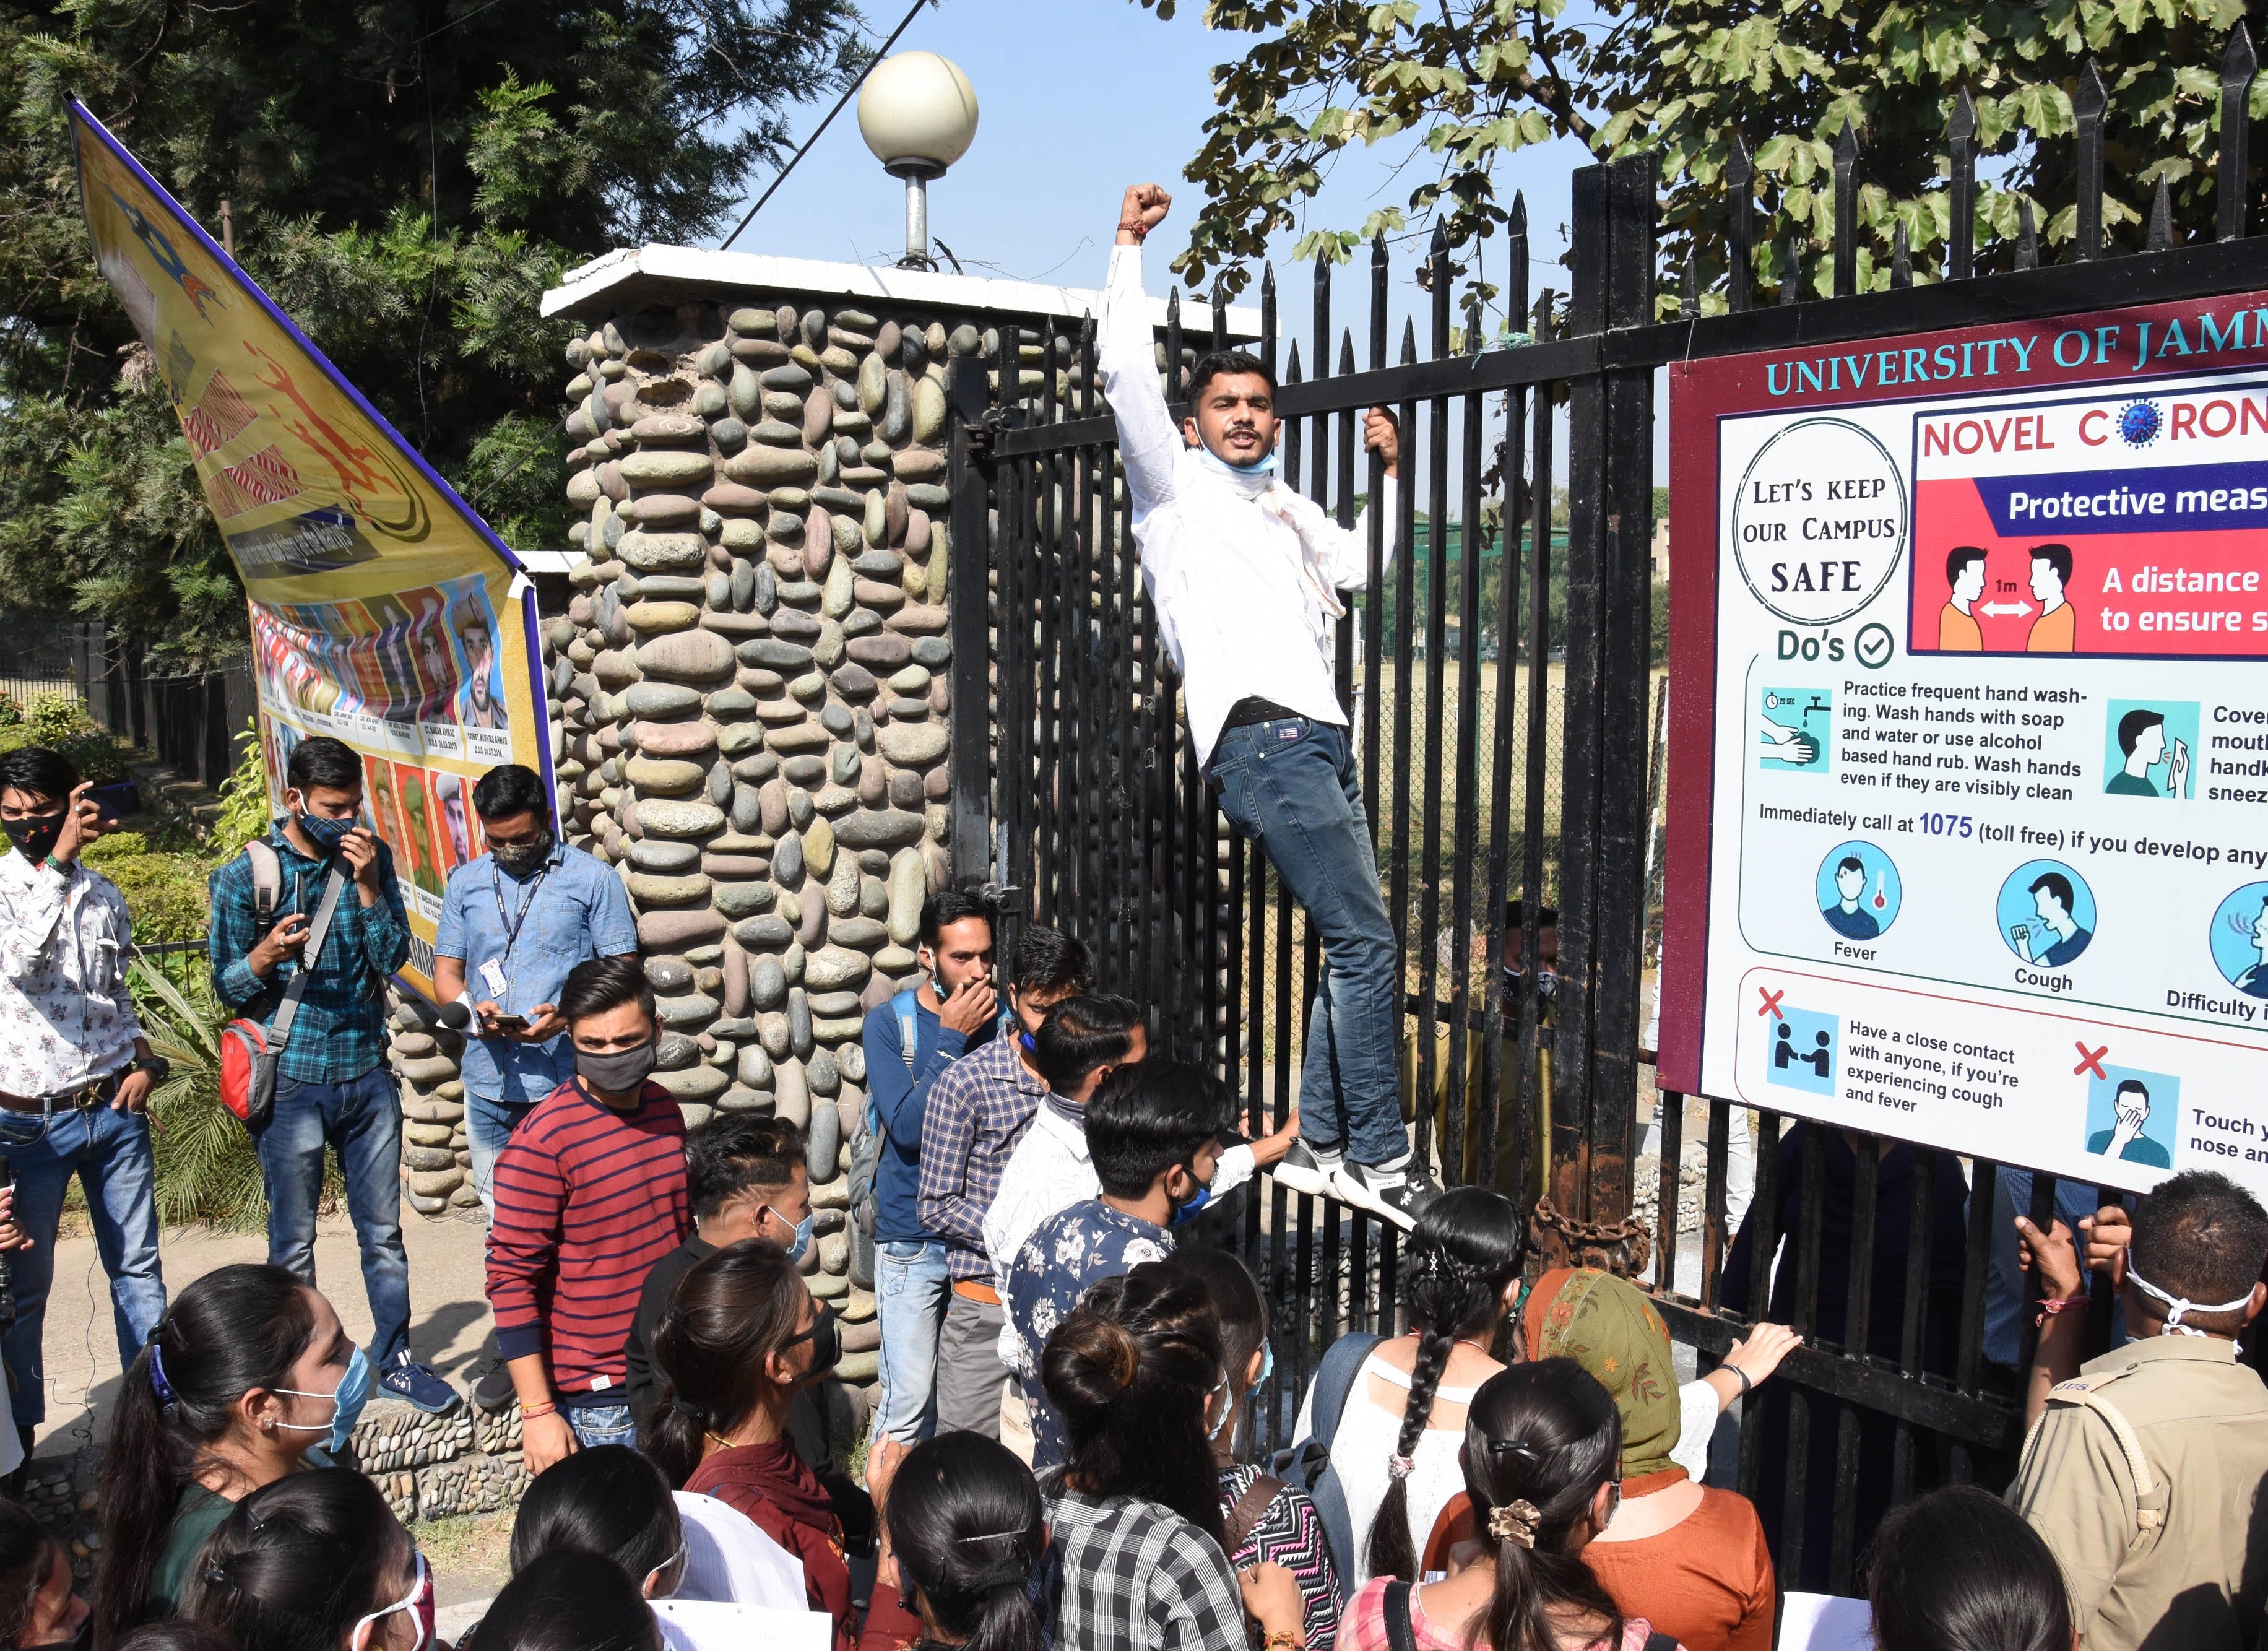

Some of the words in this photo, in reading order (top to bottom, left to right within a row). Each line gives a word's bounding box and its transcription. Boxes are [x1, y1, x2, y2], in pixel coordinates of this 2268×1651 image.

[1767, 336, 2037, 395] UNIVERSITY
[2054, 326, 2119, 367] OF
[1925, 416, 2054, 456] NOVEL
[2010, 487, 2165, 519] Protective
[1772, 561, 1861, 592] SAFE
[1996, 579, 2017, 593] 1m
[2102, 568, 2122, 592] A
[2132, 566, 2259, 592] distance
[2101, 607, 2129, 630] to
[2139, 612, 2241, 631] ensure
[1778, 629, 1844, 661] Do's
[1845, 681, 1906, 697] Practice
[1911, 683, 1980, 701] frequent
[1986, 685, 2027, 701] hand
[2034, 688, 2087, 703] wash-
[1844, 703, 1870, 721] ing.
[1876, 704, 1918, 720] Wash
[1925, 707, 1974, 723] hands
[1981, 709, 2015, 724] with
[2022, 714, 2064, 730] soap
[2214, 706, 2268, 724] Cove
[1842, 727, 1869, 740] and
[1876, 729, 1918, 743] water
[1923, 734, 1939, 744] or
[1946, 735, 1973, 746] use
[1980, 733, 2041, 750] alcohol
[1842, 748, 1887, 764] based
[1893, 751, 1931, 766] hand
[1937, 755, 1968, 769] rub.
[1975, 756, 2020, 773] Wash
[2028, 759, 2081, 776] hands
[1841, 773, 1876, 786] even
[1882, 773, 1892, 787] if
[1896, 774, 1929, 793] they
[1935, 780, 1960, 792] are
[1965, 779, 2020, 800] visibly
[2026, 784, 2072, 800] clean
[1760, 804, 1857, 830] Immediately
[1863, 815, 1891, 830] call
[1898, 818, 1913, 832] at
[1920, 813, 1972, 838] 1075
[1980, 823, 2014, 843] (toll
[2020, 826, 2064, 851] free)
[2072, 831, 2084, 847] if
[2090, 837, 2126, 854] you
[2134, 837, 2219, 865] develop
[2227, 849, 2267, 869] any
[1835, 942, 1876, 960] Fever
[2015, 968, 2072, 992] Cough
[2167, 990, 2256, 1021] Difficulty
[1851, 1021, 1887, 1039] Have
[1892, 1032, 1900, 1042] a
[1906, 1033, 1947, 1051] close
[1953, 1043, 2014, 1064] contact
[1849, 1044, 1879, 1060] with
[1885, 1053, 1945, 1075] anyone,
[1952, 1062, 1962, 1076] if
[1846, 1065, 1946, 1099] experiencing
[1952, 1088, 2002, 1109] cough
[1846, 1089, 1873, 1103] and
[1879, 1092, 1917, 1112] fever
[2192, 1109, 2254, 1135] Touch
[2191, 1137, 2238, 1157] nose
